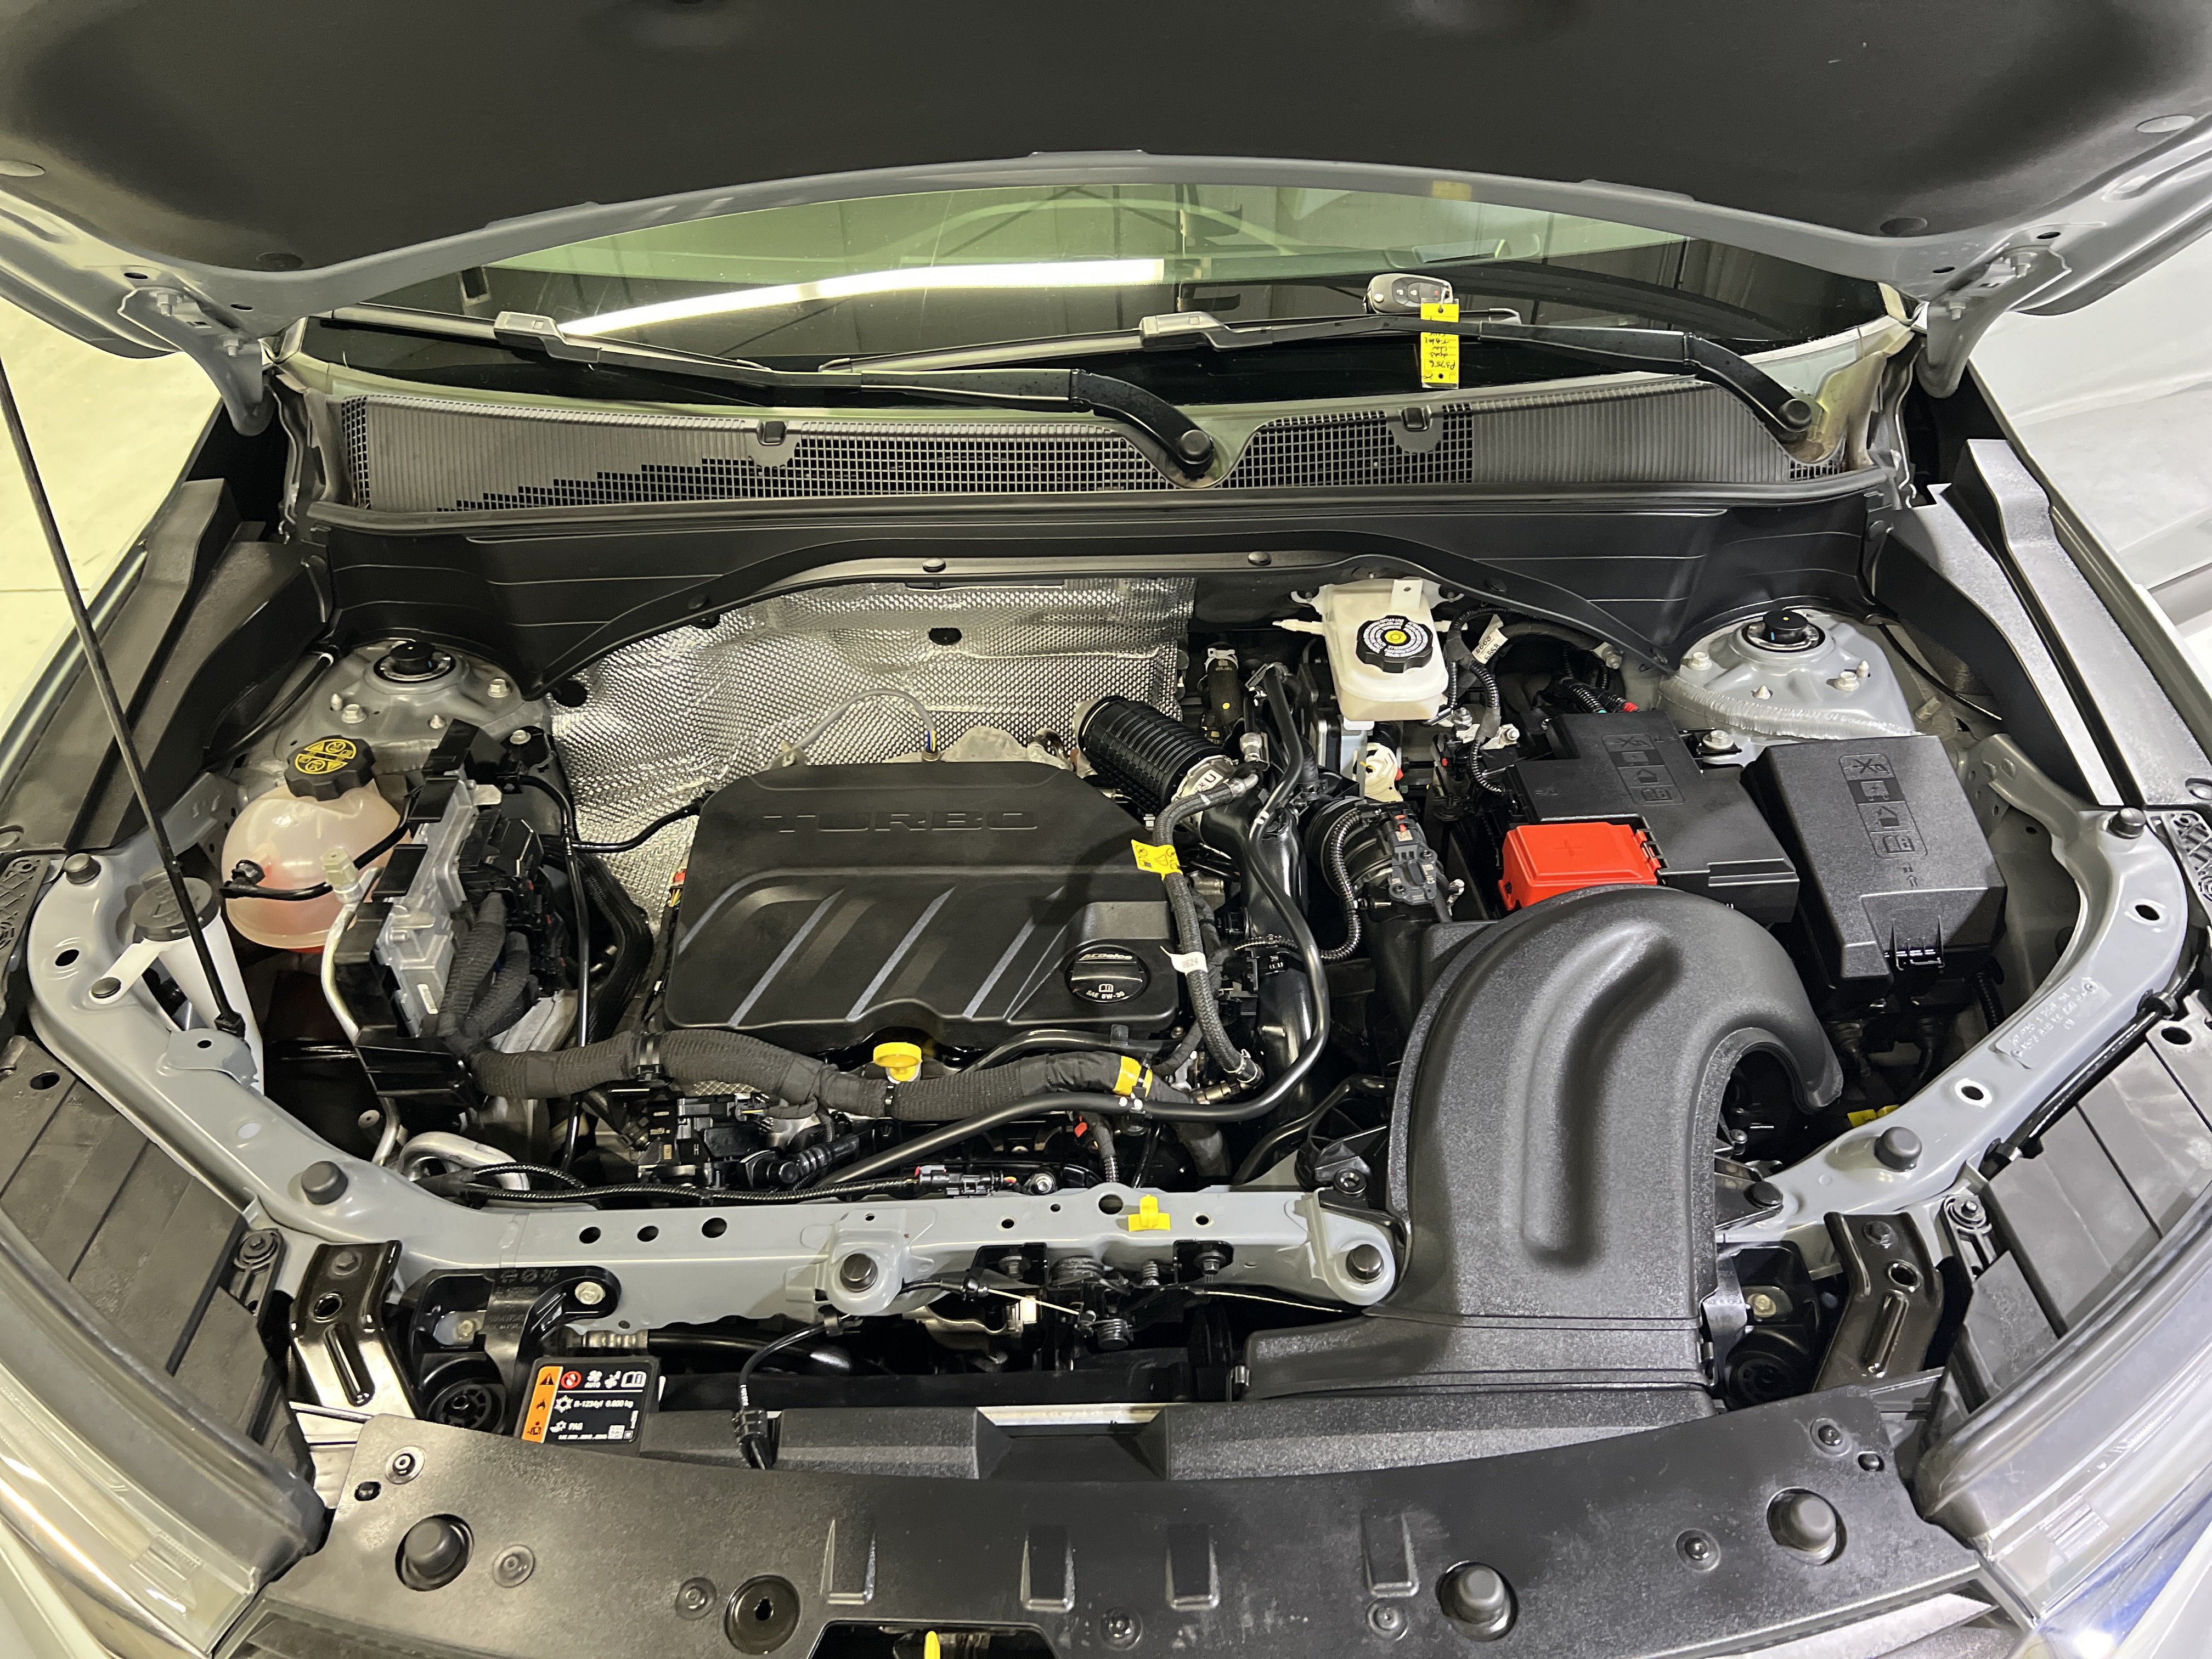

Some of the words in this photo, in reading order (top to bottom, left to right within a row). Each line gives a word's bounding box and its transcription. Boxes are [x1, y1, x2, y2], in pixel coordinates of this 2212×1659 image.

[763, 811, 1037, 833] TURBO
[1086, 990, 1099, 998] SAE
[1102, 991, 1125, 1000] 5W-30
